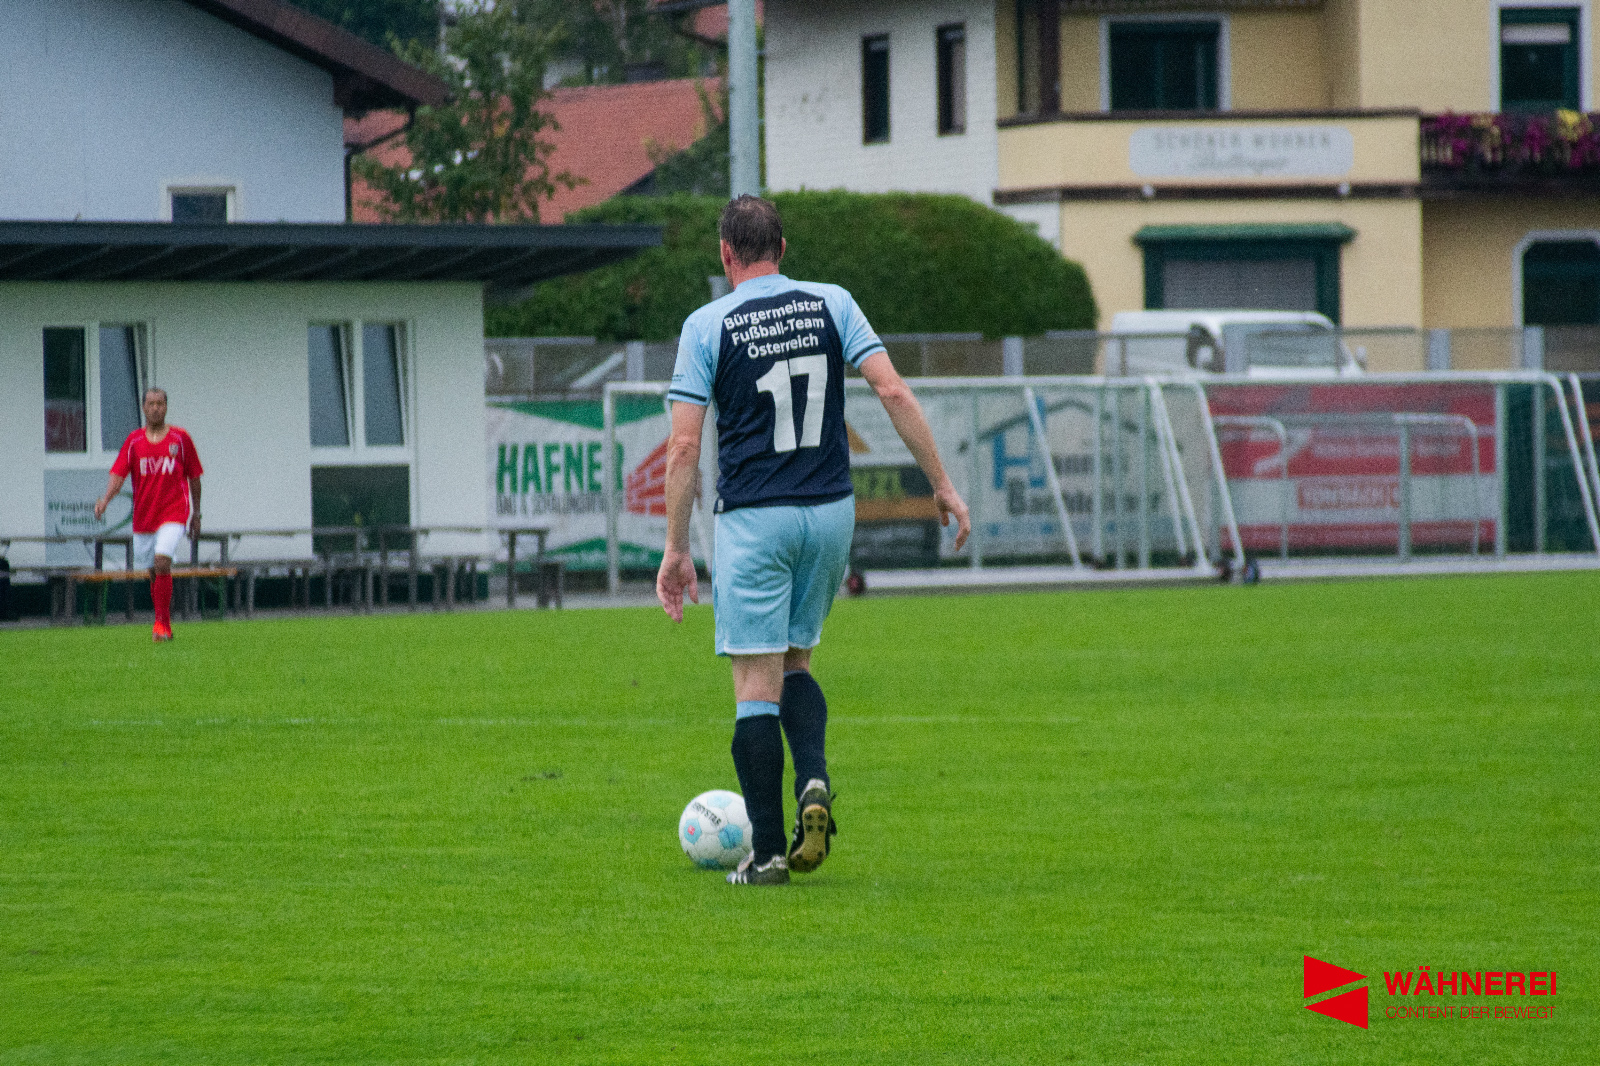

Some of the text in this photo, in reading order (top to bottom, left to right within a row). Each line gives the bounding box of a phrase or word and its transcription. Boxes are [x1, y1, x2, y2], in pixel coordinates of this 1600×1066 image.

[723, 299, 824, 331] Bürgermeister
[731, 317, 825, 346] Fußball-Team
[747, 332, 819, 359] Österreich
[756, 353, 828, 453] 17
